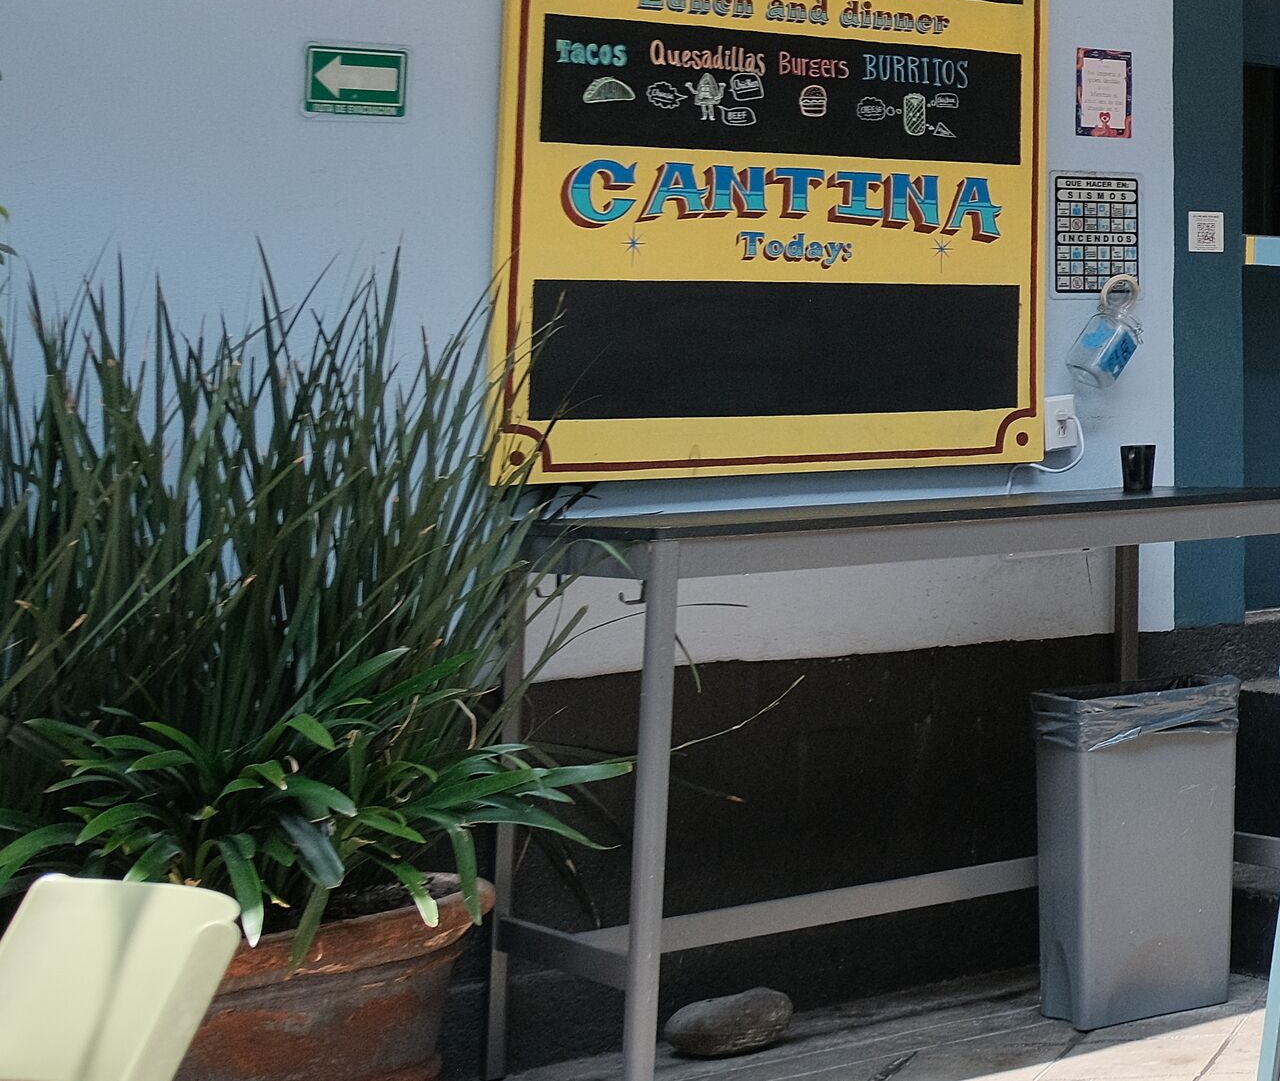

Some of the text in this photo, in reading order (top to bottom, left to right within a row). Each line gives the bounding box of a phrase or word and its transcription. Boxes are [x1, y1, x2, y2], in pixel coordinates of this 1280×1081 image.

[556, 39, 969, 89] Tacos Quesadillas Burgers BURRITOS
[560, 158, 1003, 244] CANTINA
[1067, 191, 1127, 200] SISMOS
[736, 230, 854, 269] Today:
[1062, 234, 1132, 242] INCENDIOS
